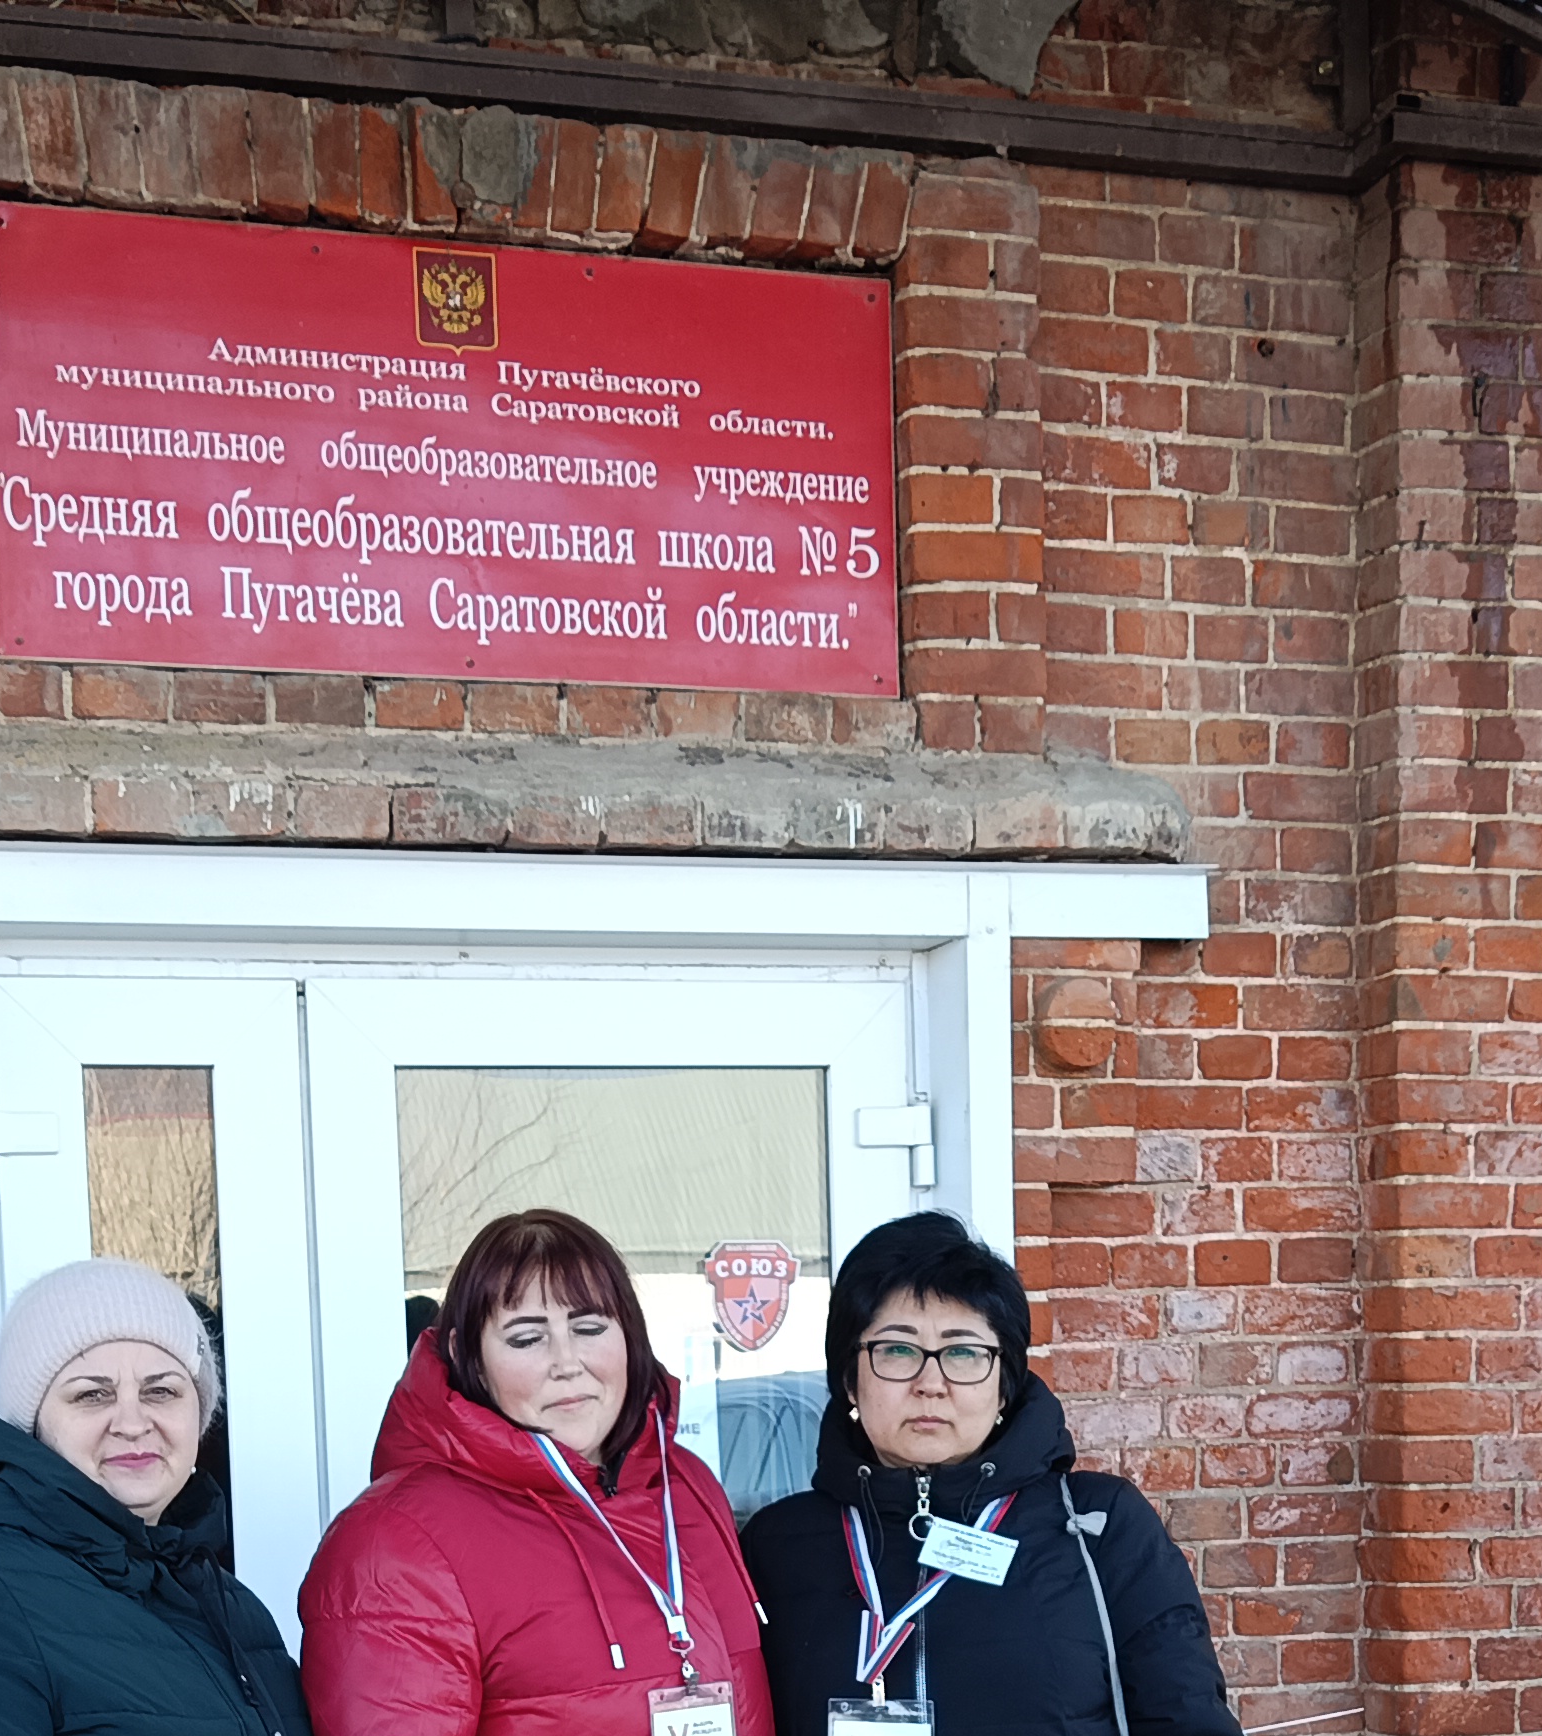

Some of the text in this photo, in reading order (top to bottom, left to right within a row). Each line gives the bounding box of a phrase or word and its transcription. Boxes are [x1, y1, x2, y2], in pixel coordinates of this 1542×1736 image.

[56, 364, 835, 440] муниципального района Саратовской области.
[207, 337, 701, 398] Администрация Пугачёвского
[15, 408, 870, 505] Муниципальное общеобразовательное учреждение
[207, 488, 636, 566] общеобразовательная
[658, 528, 776, 574] школа
[52, 566, 858, 650] города Пугачёва Саратовской области."
[714, 1258, 788, 1278] СОЮЗ
